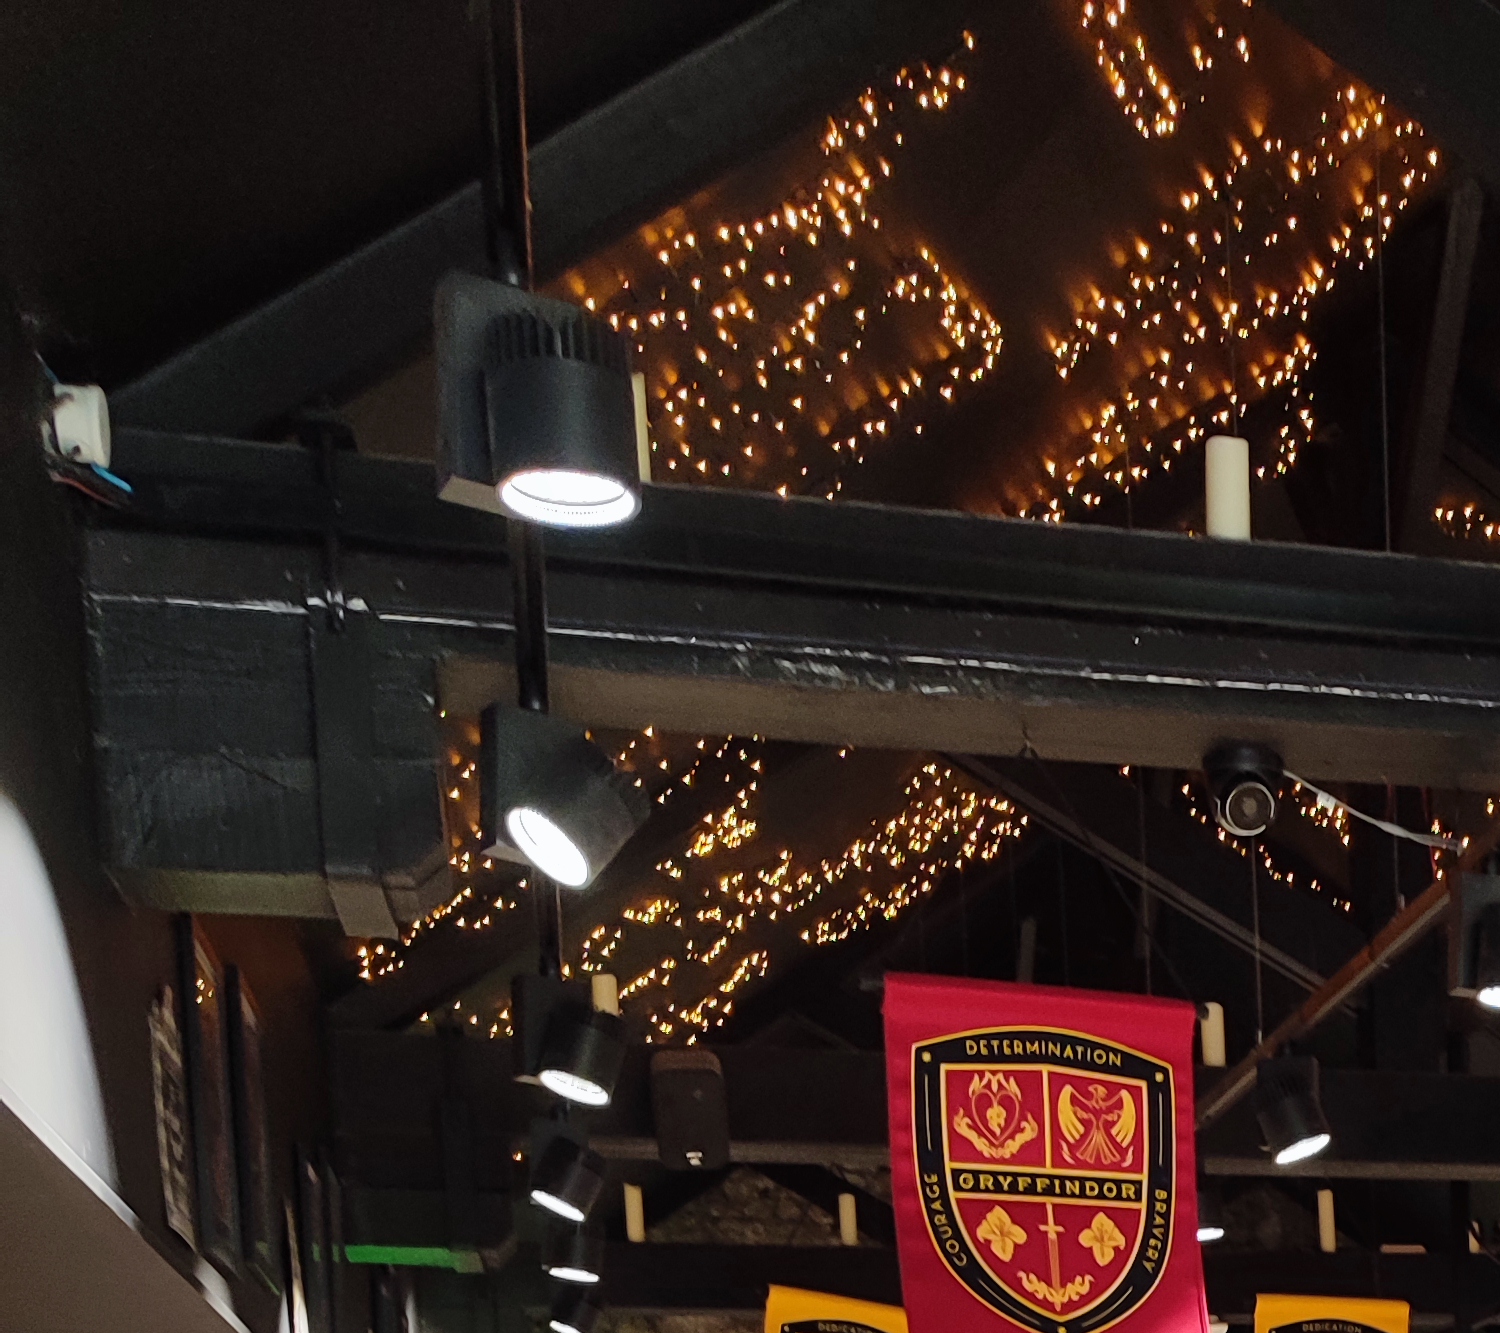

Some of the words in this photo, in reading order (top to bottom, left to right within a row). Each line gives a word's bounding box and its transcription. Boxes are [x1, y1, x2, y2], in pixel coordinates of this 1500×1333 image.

[966, 1038, 1122, 1068] DETERMINATION
[958, 1172, 1137, 1200] GRYFFINDOR
[923, 1172, 968, 1267] COURAGE
[1144, 1188, 1168, 1275] BRAVERY
